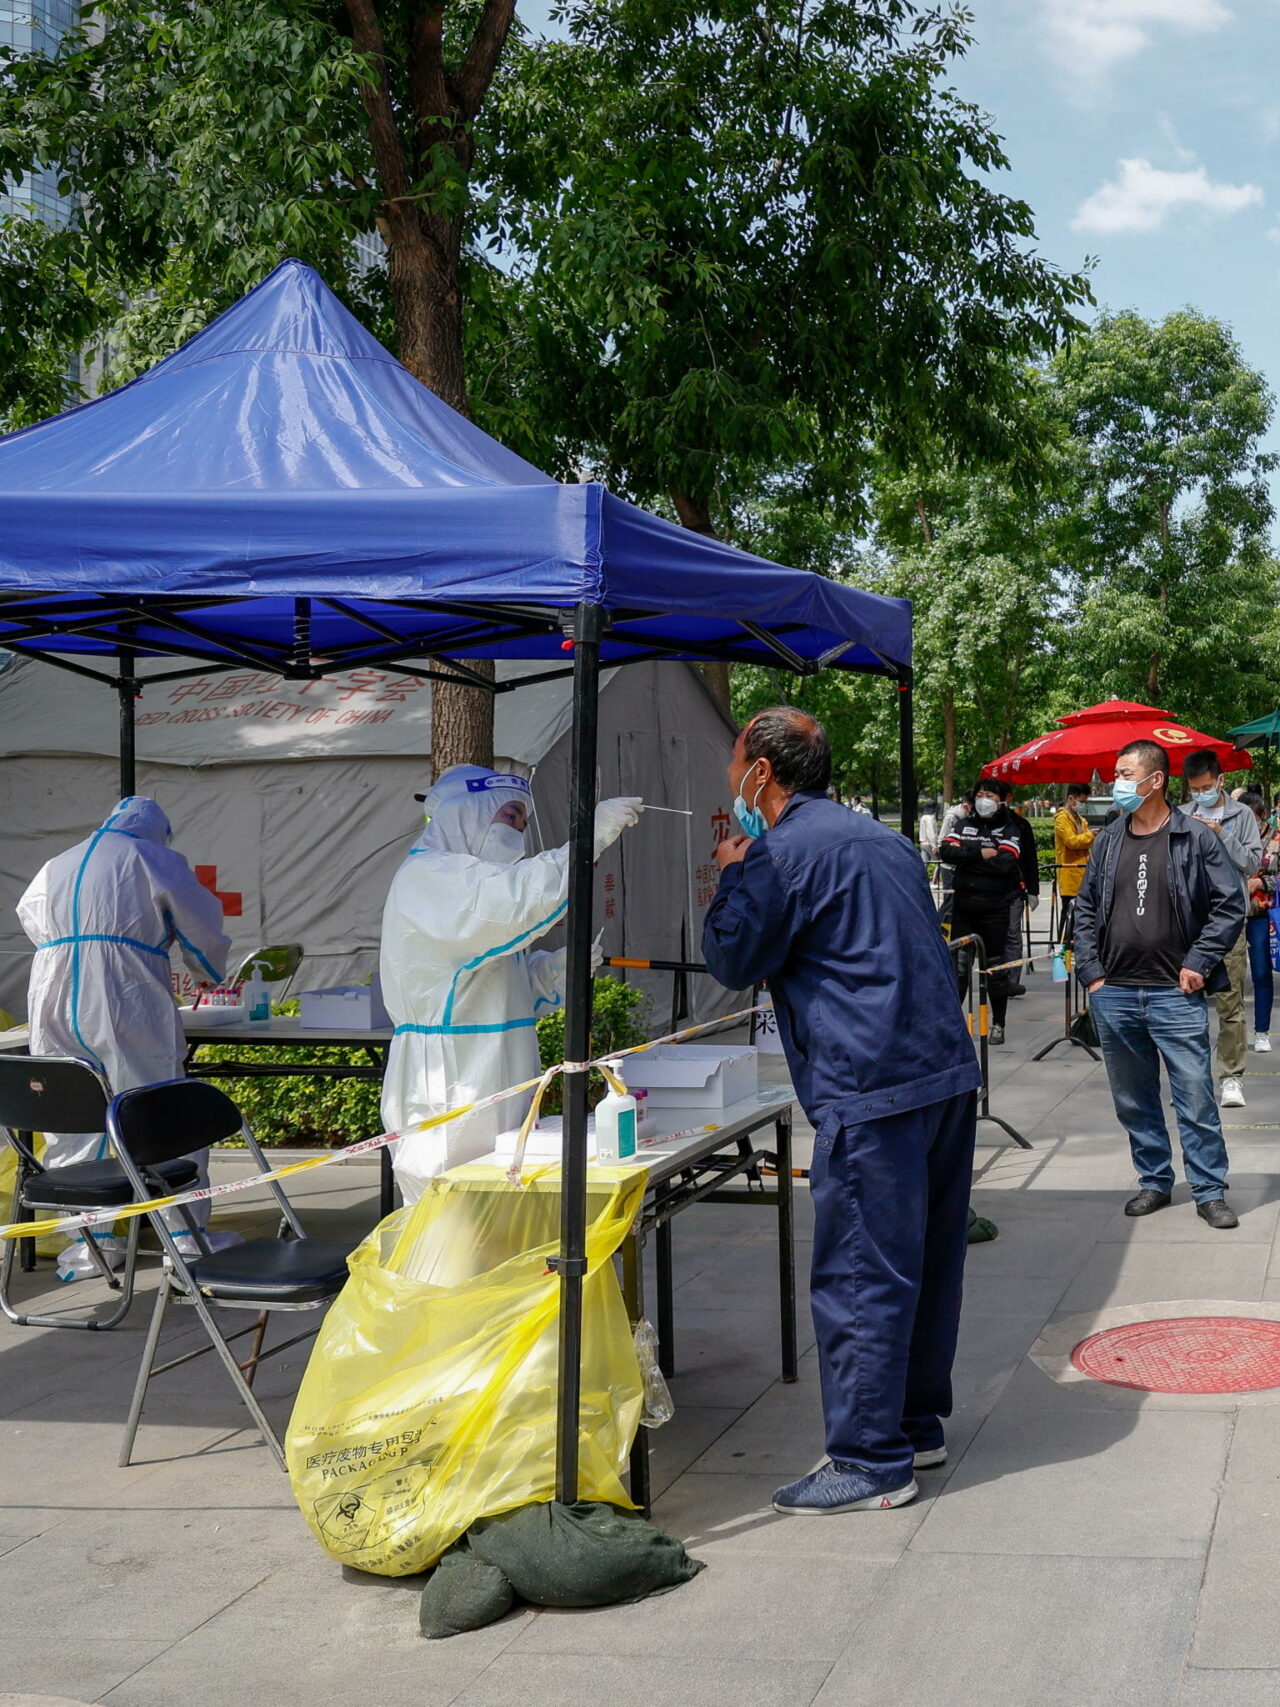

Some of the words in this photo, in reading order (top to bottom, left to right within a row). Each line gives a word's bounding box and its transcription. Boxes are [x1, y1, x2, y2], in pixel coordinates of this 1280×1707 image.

[166, 706, 227, 724] CROSS
[304, 707, 338, 724] OF
[335, 709, 396, 725] CHINA
